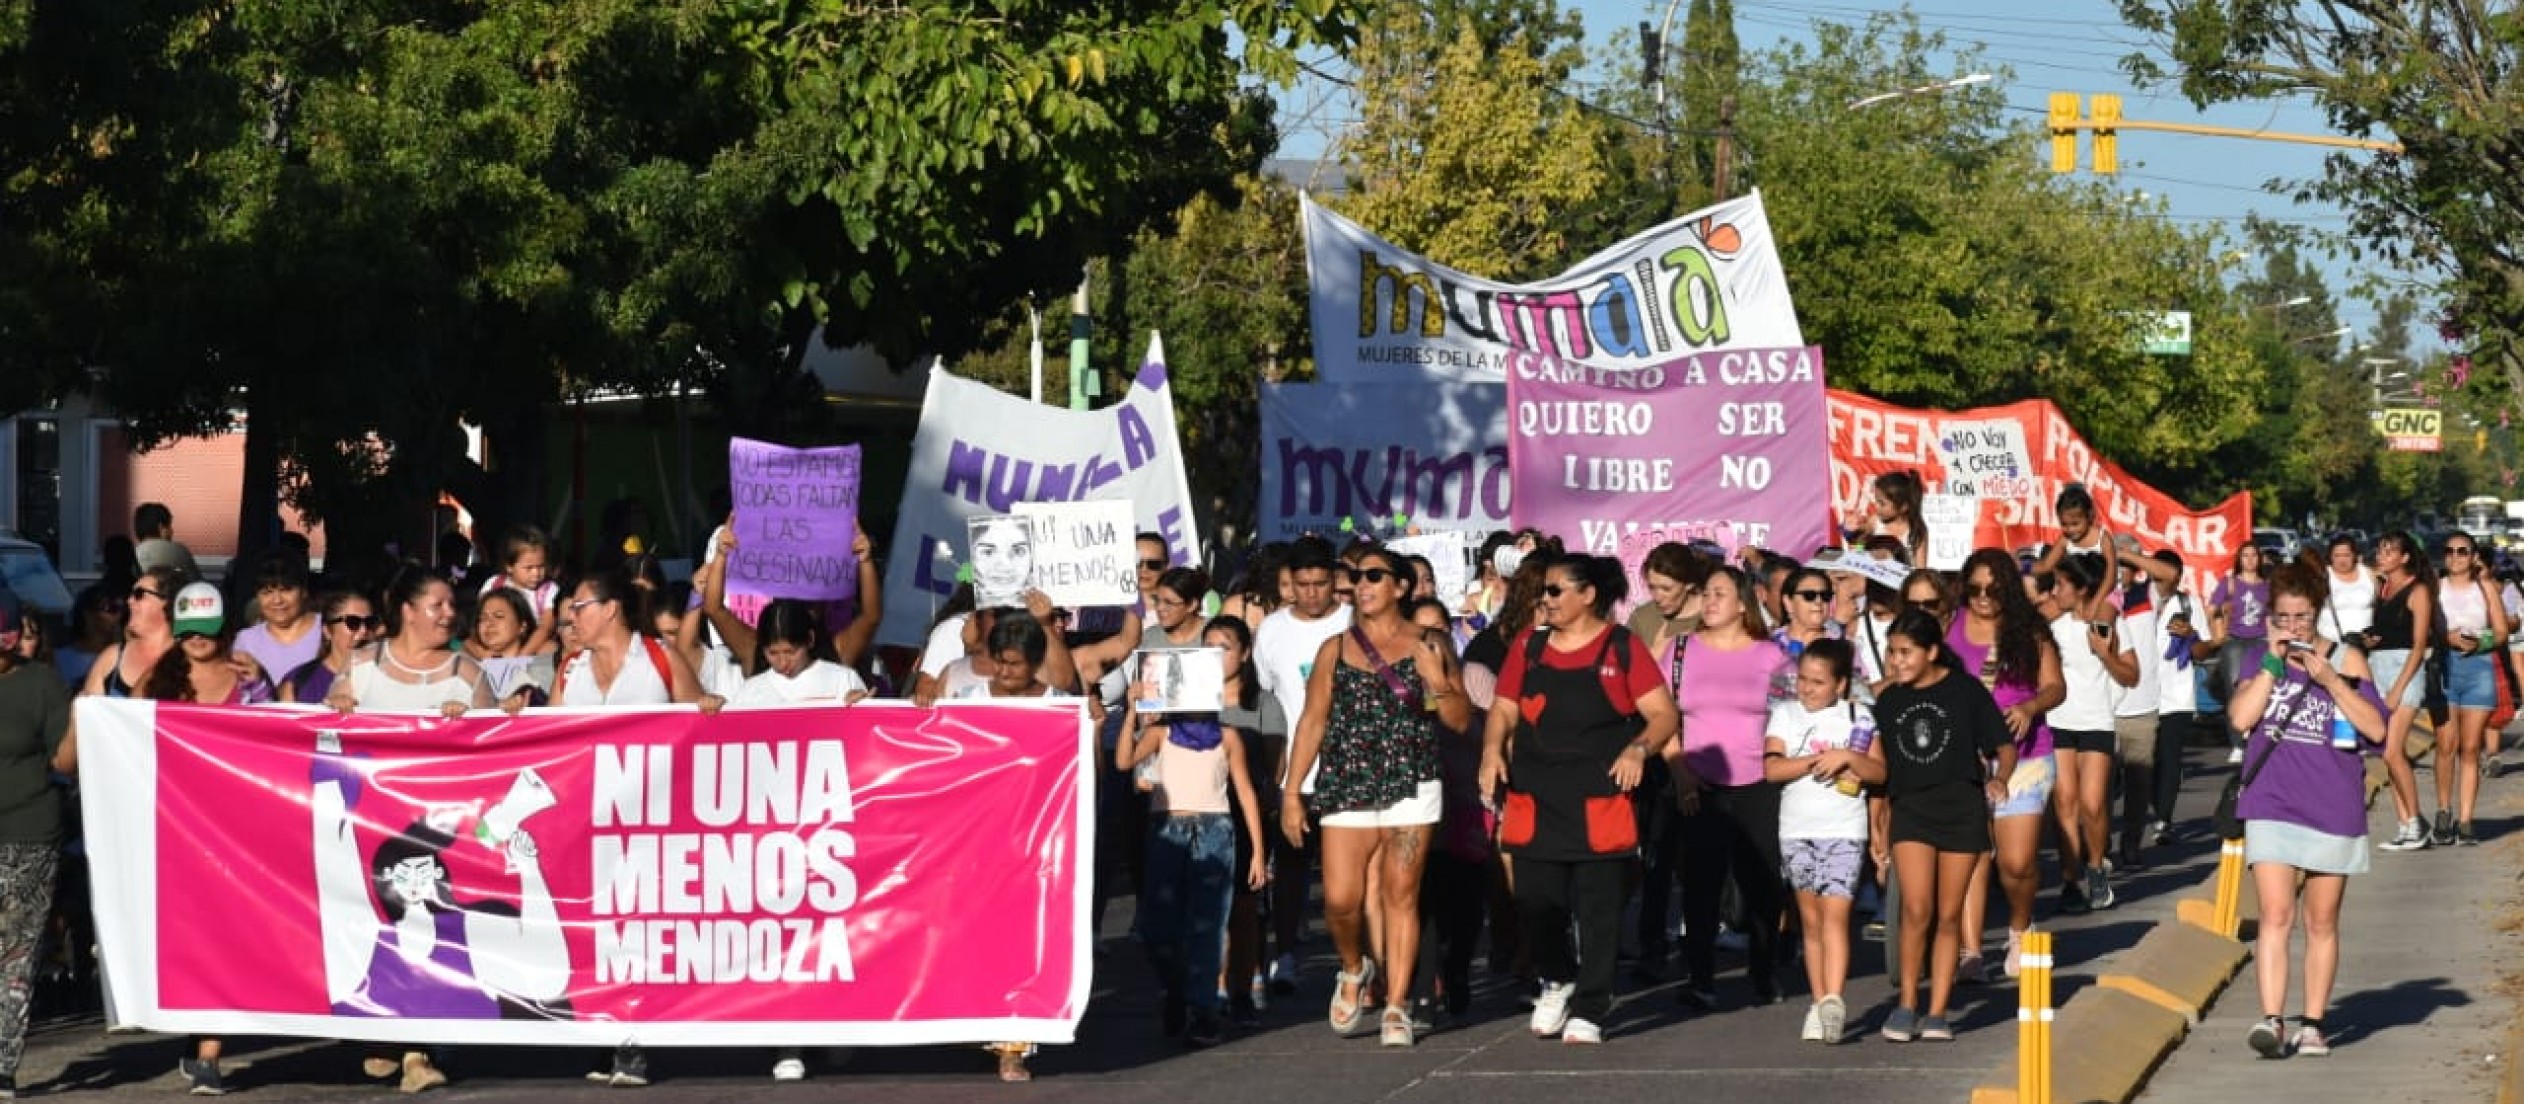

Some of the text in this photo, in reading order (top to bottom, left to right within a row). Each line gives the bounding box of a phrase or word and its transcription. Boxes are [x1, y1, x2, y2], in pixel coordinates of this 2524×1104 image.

[1358, 346, 1433, 364] MUJERES
[1439, 351, 1462, 366] DE
[1466, 352, 1488, 369] LA
[1515, 354, 1665, 389] CAMINO
[1685, 356, 1708, 384] A
[1719, 351, 1813, 385] CASA
[1519, 401, 1786, 437] QUIERO SER
[2386, 412, 2437, 434] GNC
[1952, 427, 2006, 450] NO VOY
[943, 403, 1158, 513] MUMALA
[1564, 455, 1772, 493] LIBRE NO
[1826, 396, 2228, 555] FREN POPULAR
[1278, 437, 1512, 521] muma
[1952, 479, 1975, 496] CON
[762, 515, 813, 542] LAS
[1071, 519, 1117, 548] UNA
[1037, 553, 1119, 588] MENOS
[592, 739, 855, 827] NI UNA
[592, 830, 857, 916] MENOS
[594, 917, 856, 984] MENDOZA
